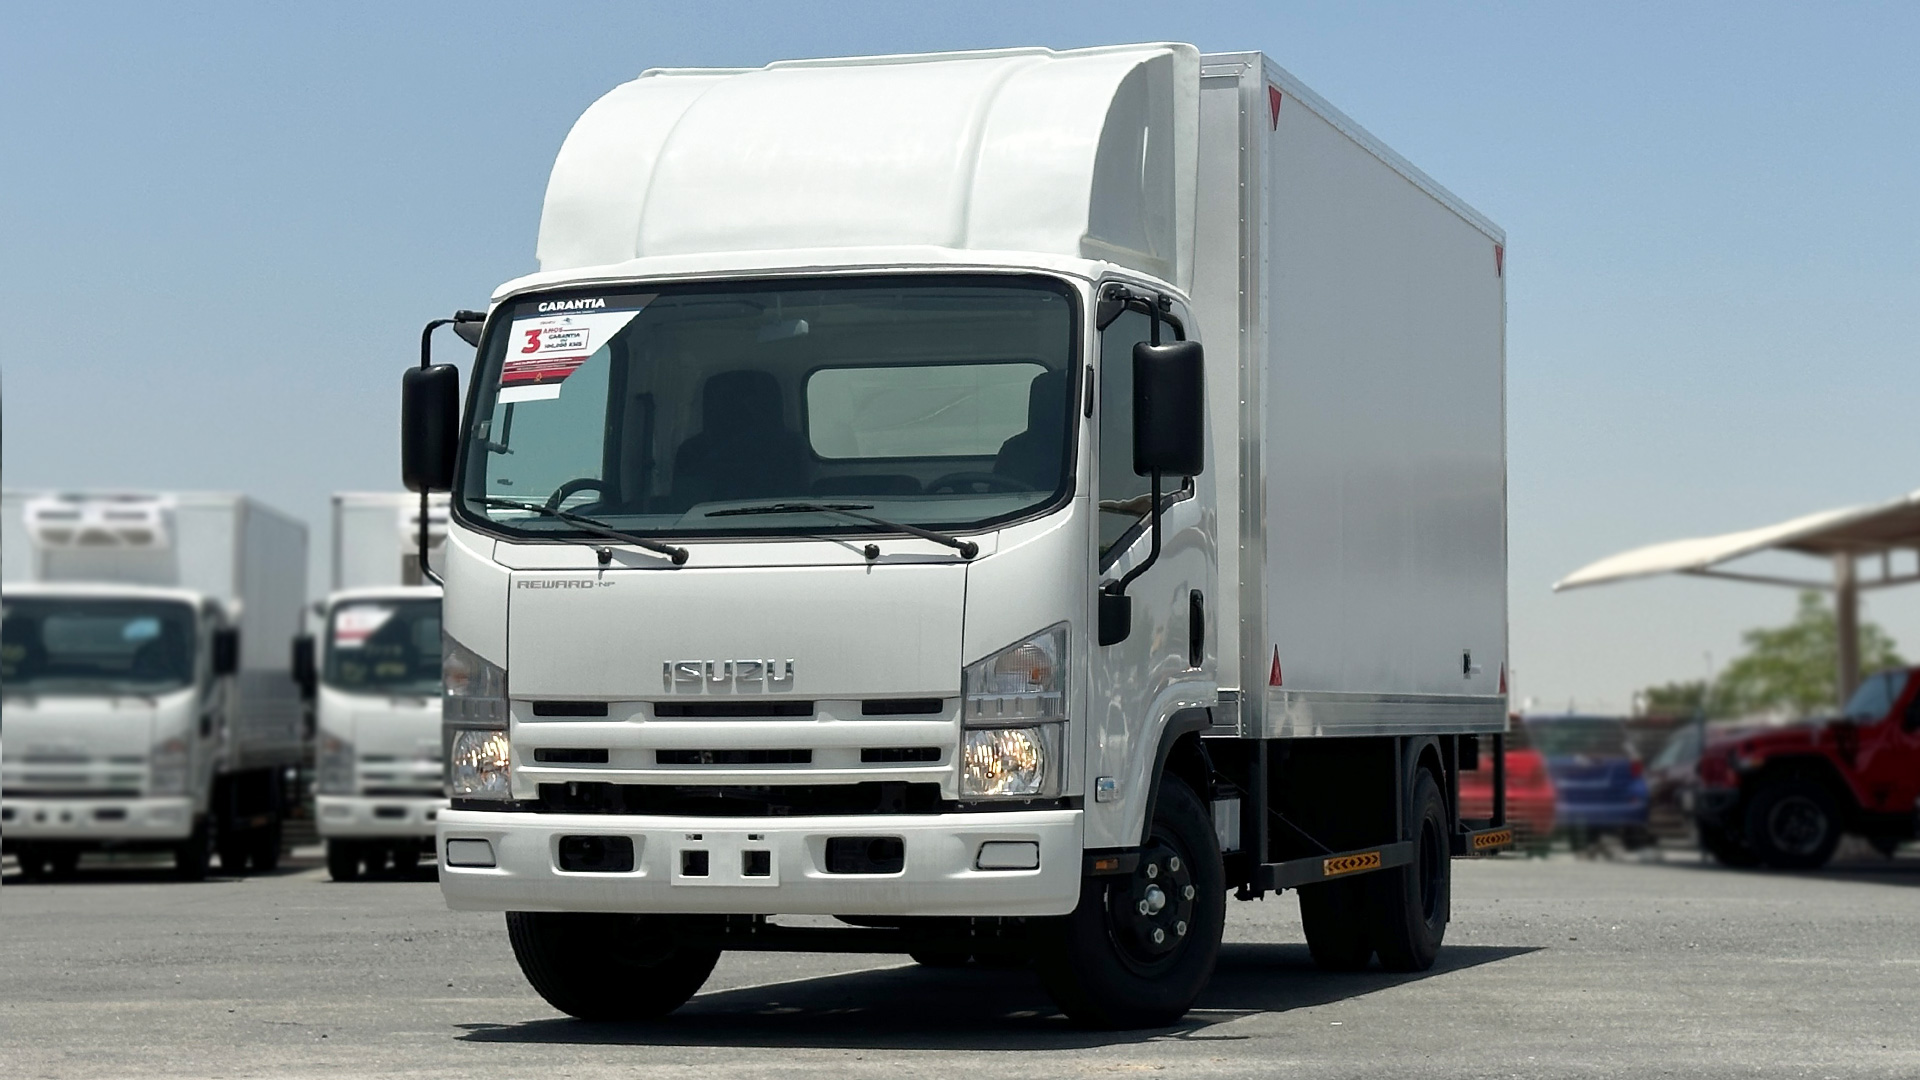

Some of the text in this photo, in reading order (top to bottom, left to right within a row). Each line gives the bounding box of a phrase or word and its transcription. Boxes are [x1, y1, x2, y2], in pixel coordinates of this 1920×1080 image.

[538, 298, 605, 312] GARANTIA
[521, 328, 542, 353] 3
[663, 659, 794, 694] ISUZU
